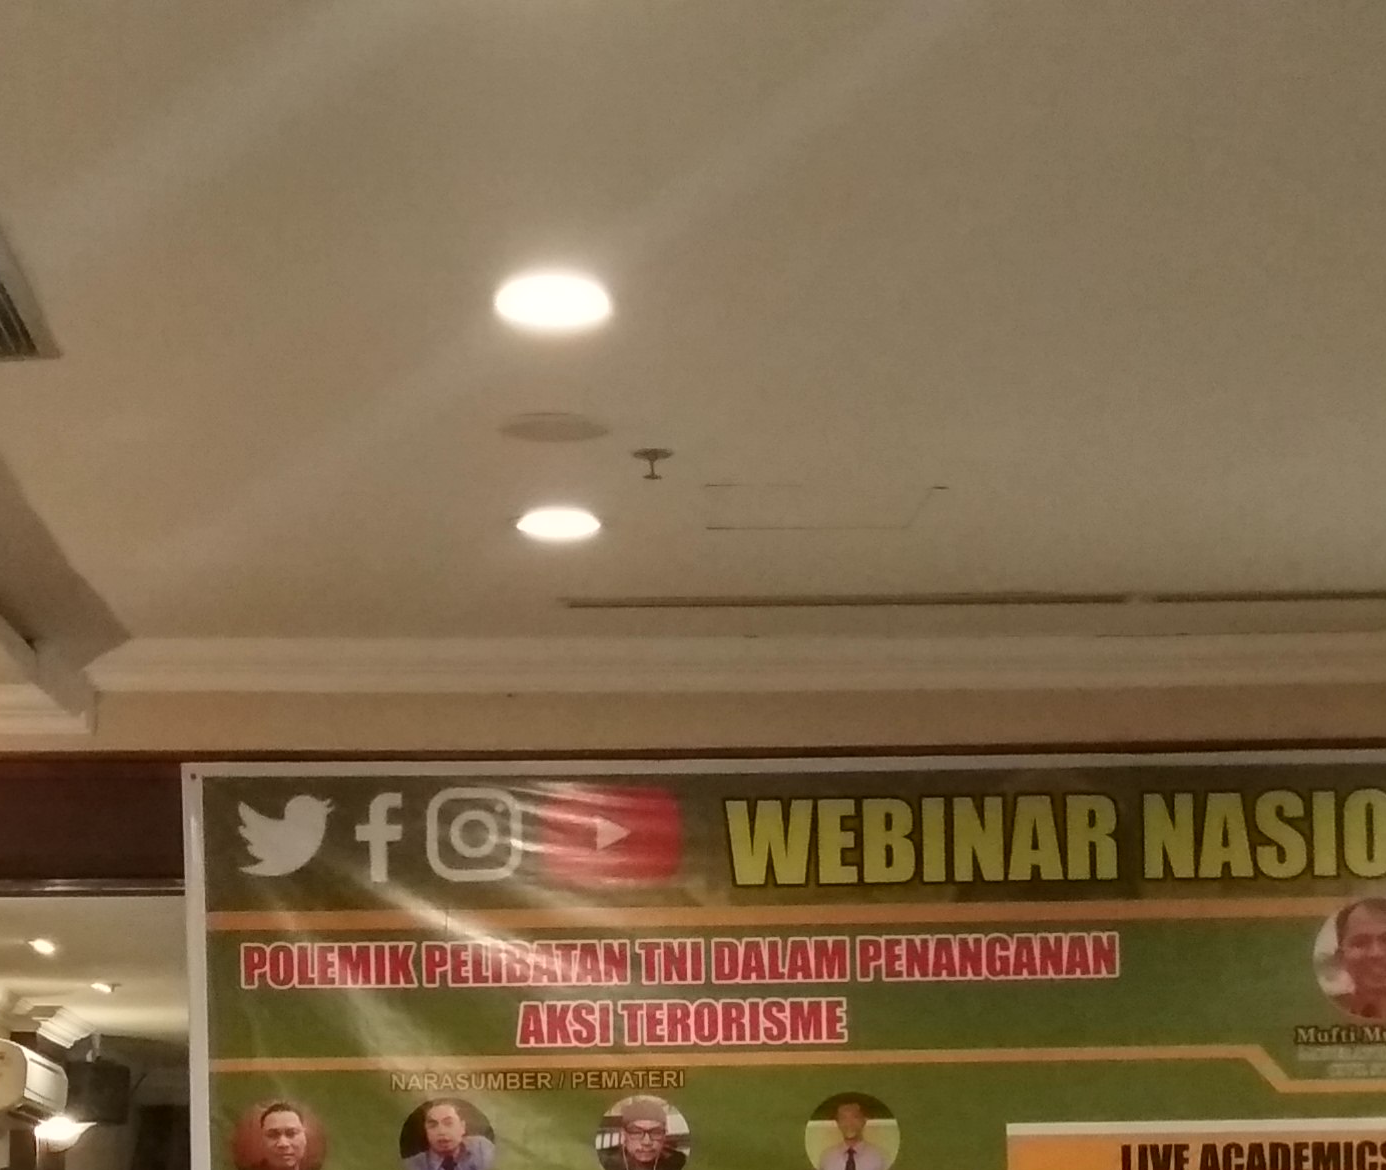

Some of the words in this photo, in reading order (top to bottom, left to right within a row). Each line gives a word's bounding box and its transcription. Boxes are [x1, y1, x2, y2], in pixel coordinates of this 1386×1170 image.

[725, 794, 1120, 886] WEBINAR
[241, 942, 417, 988] POLEMIK
[422, 940, 630, 987] PELIBATAN
[637, 938, 704, 985] TNI
[712, 935, 849, 983] DALAM
[857, 932, 1119, 980] PENANGANAN
[516, 1001, 613, 1047] AKSI
[618, 997, 847, 1046] TERORISME
[1295, 1026, 1356, 1043] Mufti
[390, 1071, 552, 1090] NARASUMBER
[571, 1070, 685, 1089] PEMATERI
